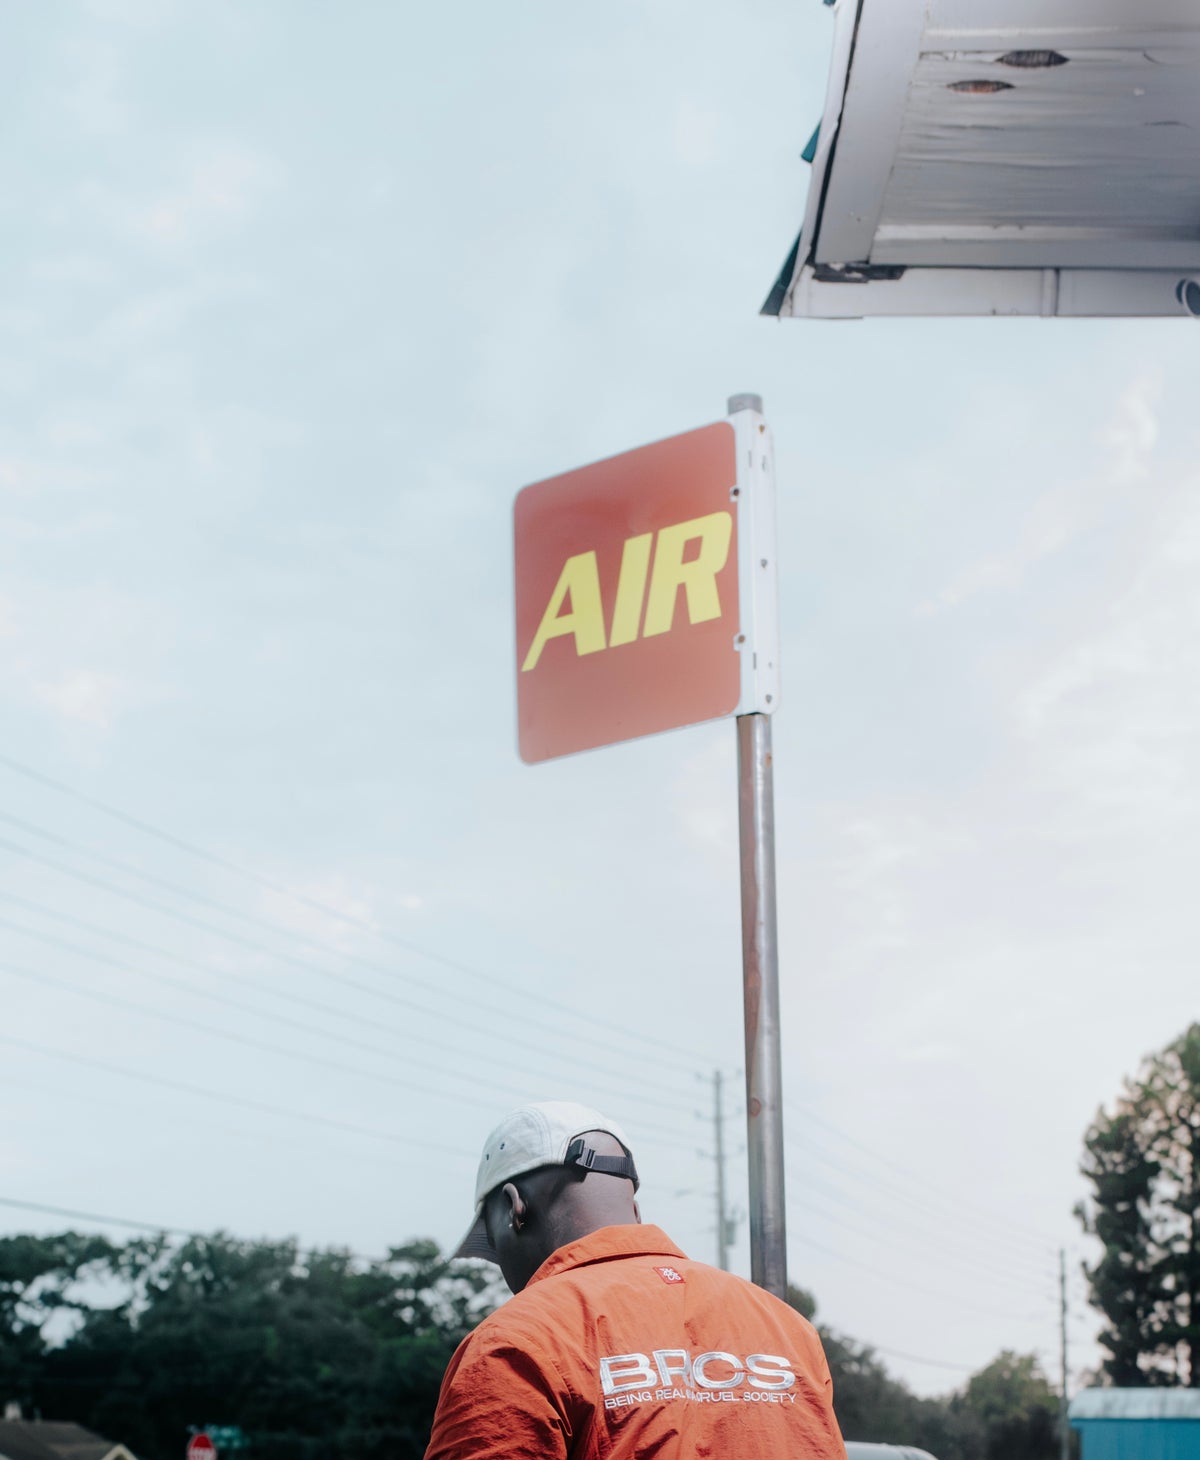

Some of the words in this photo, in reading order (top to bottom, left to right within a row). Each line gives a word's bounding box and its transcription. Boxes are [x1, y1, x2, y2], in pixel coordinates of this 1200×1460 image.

[521, 511, 732, 672] AIR
[605, 1391, 652, 1409] BEING
[743, 1391, 797, 1404] SOCIETY
